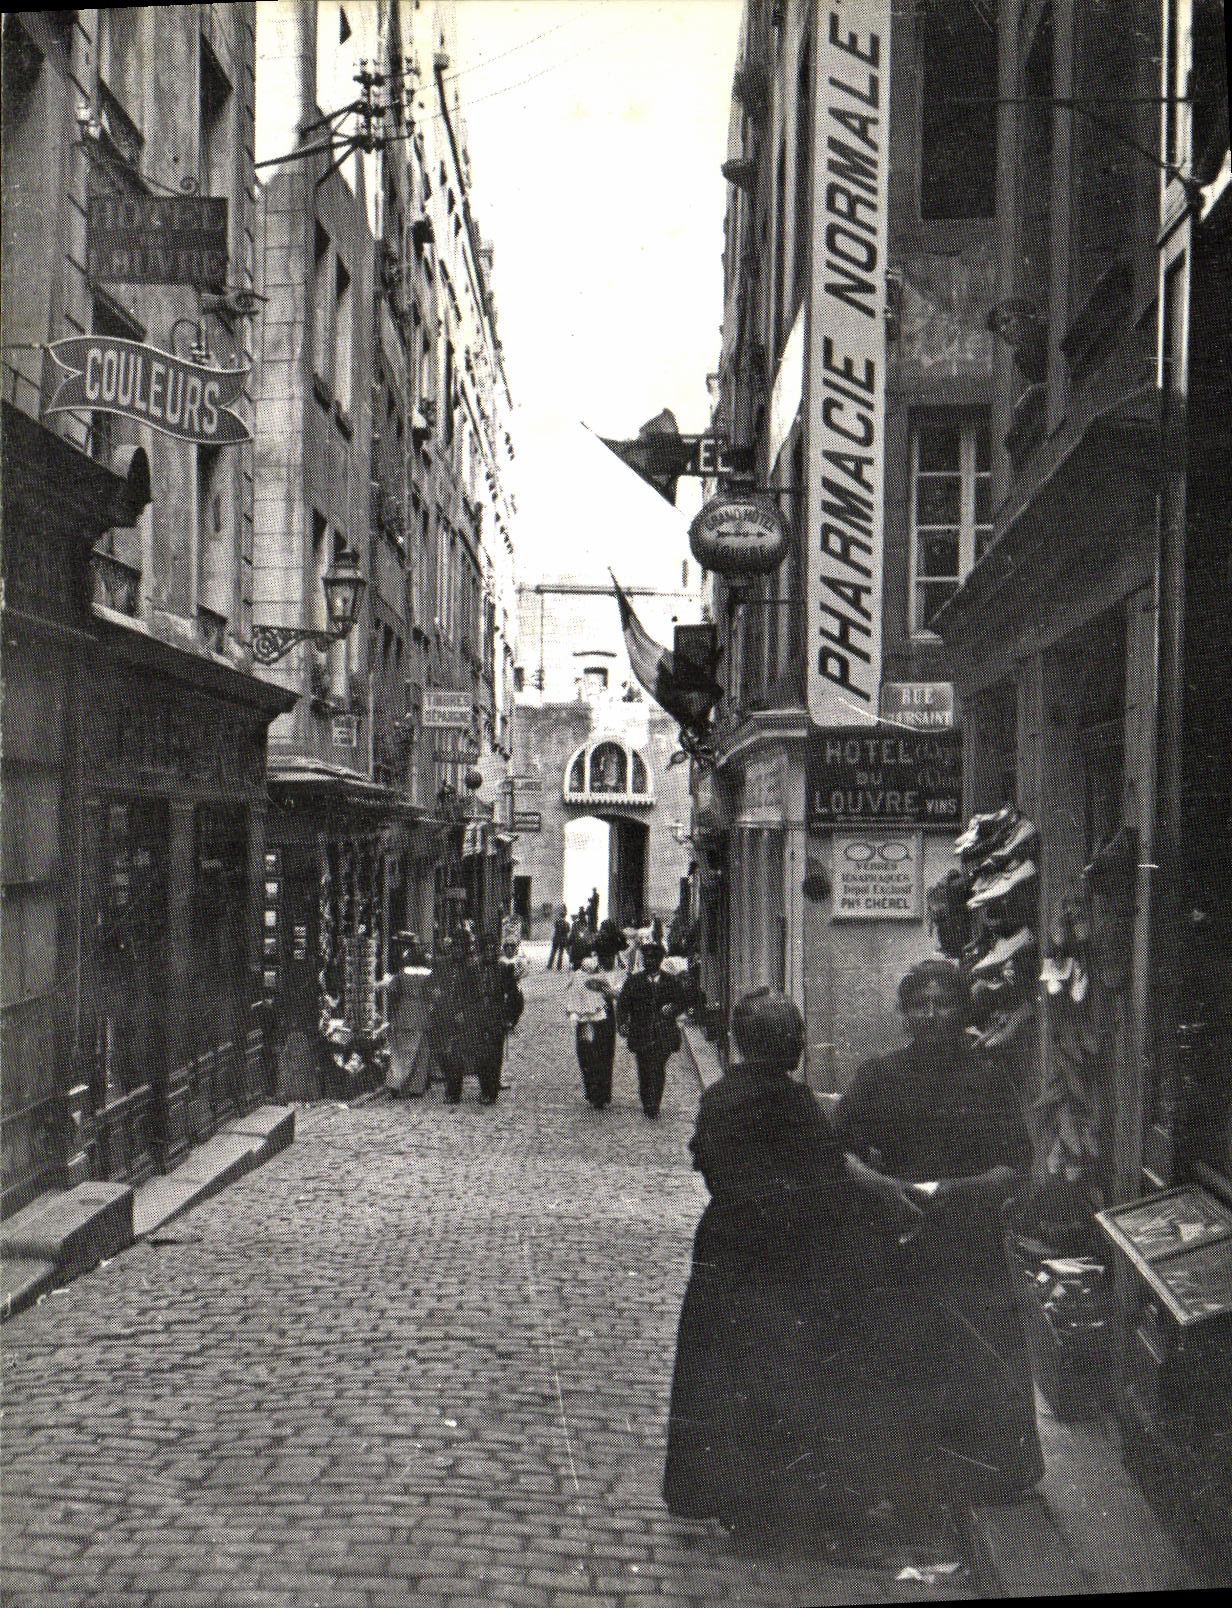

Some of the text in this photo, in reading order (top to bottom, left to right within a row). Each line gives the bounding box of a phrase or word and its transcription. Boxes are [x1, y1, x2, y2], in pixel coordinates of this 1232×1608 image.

[818, 12, 882, 702] PHARMACIE NORMALE
[84, 347, 221, 435] COULEURS
[901, 687, 934, 705] RUE
[825, 738, 914, 766] HOTEL
[855, 770, 883, 786] DU
[814, 790, 919, 814] LOUVRE
[925, 798, 958, 816] VINS
